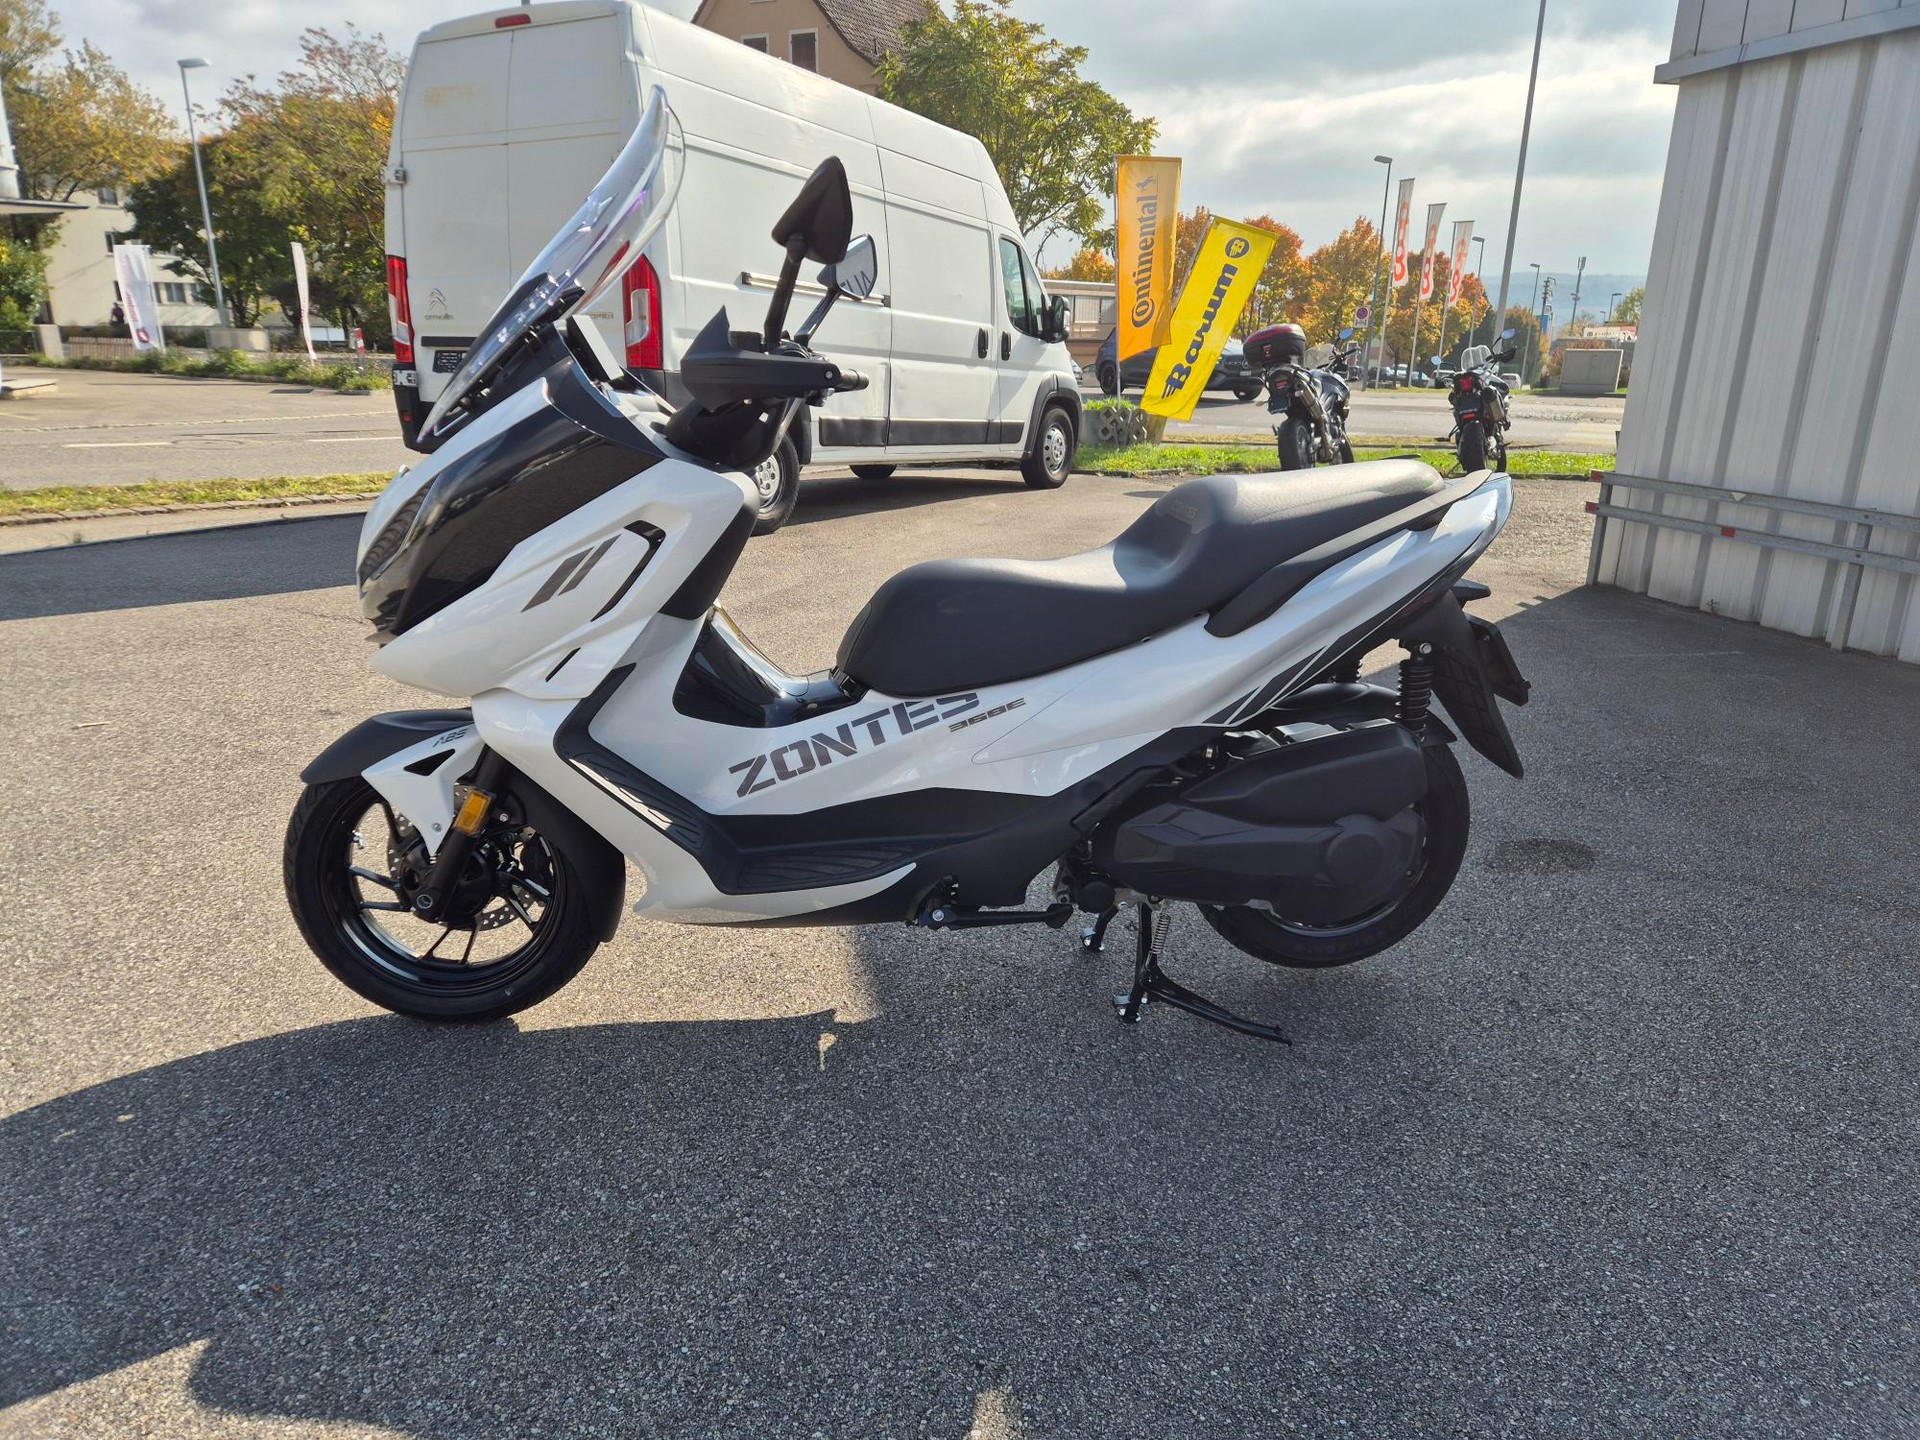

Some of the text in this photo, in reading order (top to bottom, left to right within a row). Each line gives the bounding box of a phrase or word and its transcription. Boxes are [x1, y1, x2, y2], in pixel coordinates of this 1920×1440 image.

[1131, 194, 1158, 328] Continental
[1161, 263, 1239, 399] Barum
[728, 692, 980, 798] ZONTES
